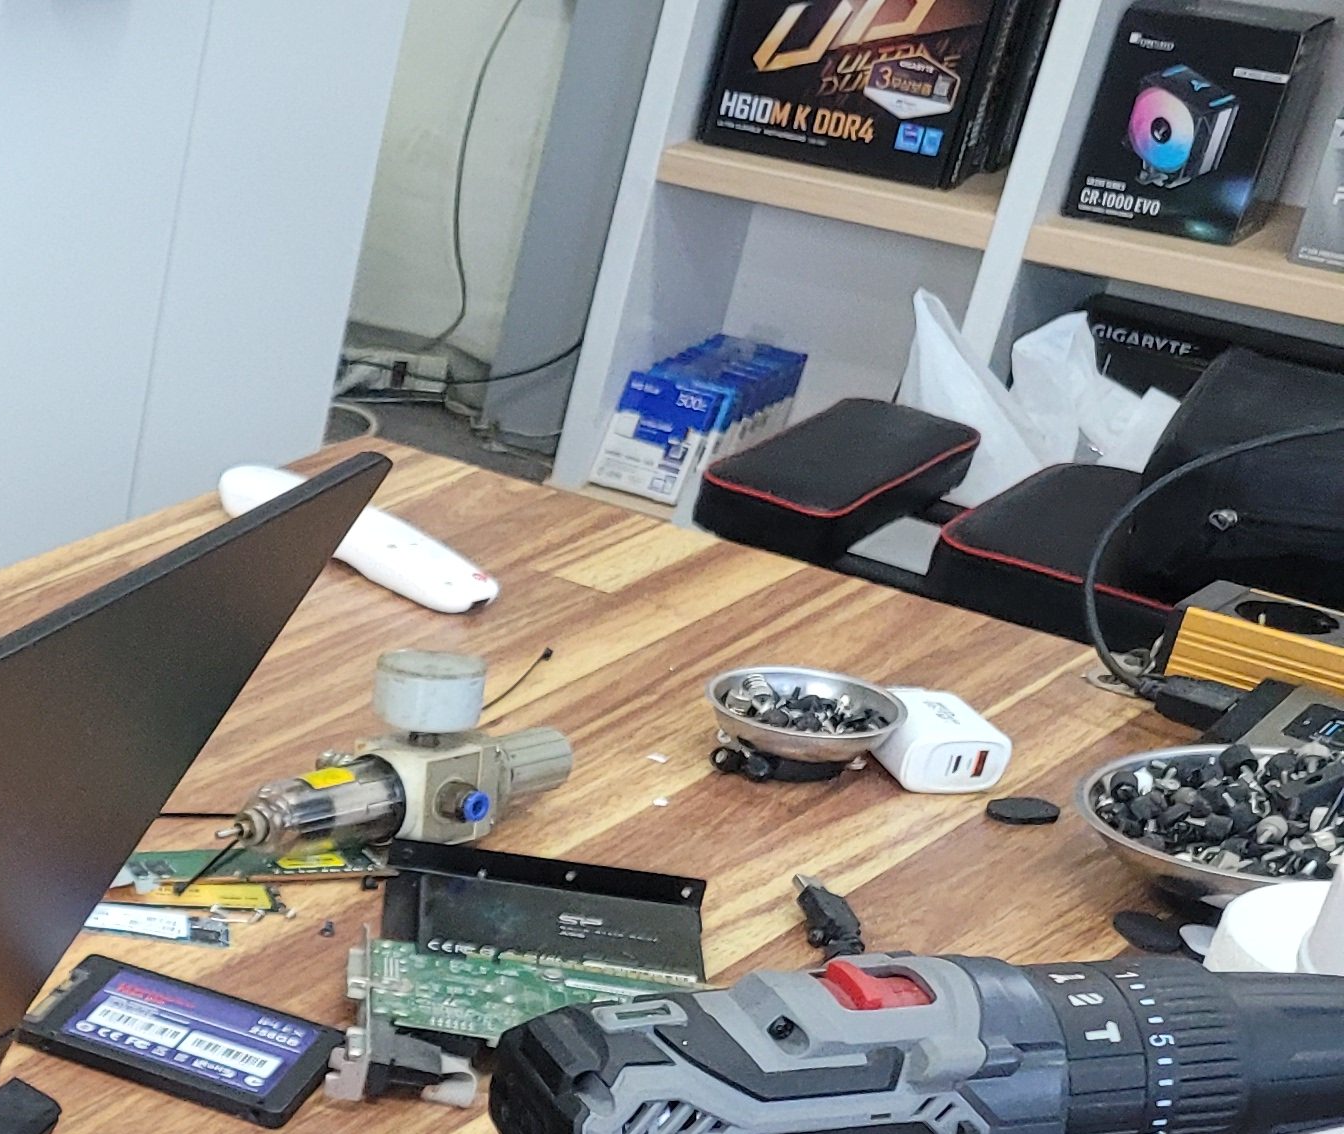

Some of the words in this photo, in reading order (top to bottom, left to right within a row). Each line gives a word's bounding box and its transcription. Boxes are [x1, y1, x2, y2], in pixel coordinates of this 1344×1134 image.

[720, 88, 790, 129] H610M
[794, 104, 812, 132] K
[813, 107, 875, 144] DDR4
[1133, 197, 1162, 217] EVO
[1092, 323, 1193, 356] GIGABYTE
